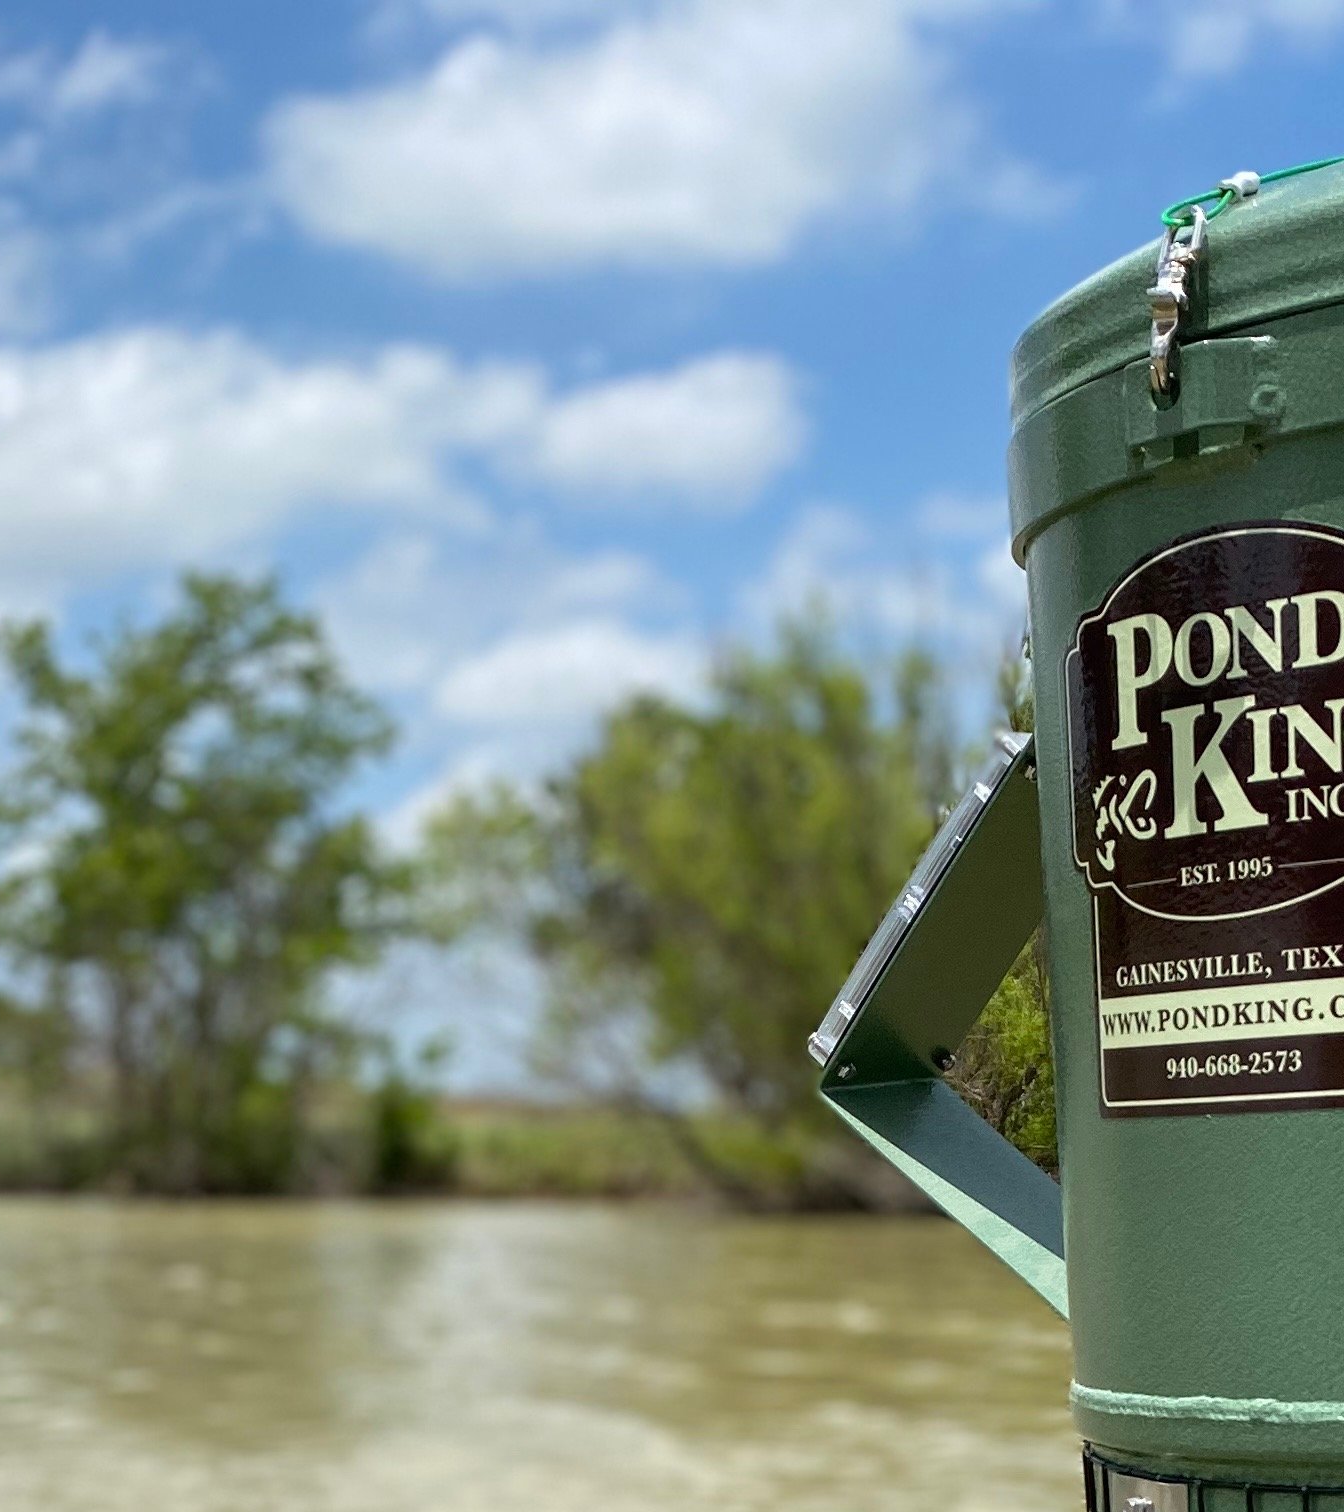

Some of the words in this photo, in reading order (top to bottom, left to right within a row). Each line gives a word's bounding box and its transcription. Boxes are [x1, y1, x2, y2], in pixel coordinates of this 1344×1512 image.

[1180, 864, 1222, 888] EST.
[1227, 856, 1274, 881] 1995
[1116, 951, 1273, 988] GAINESVILLE,
[1166, 1049, 1303, 1080] 940-668-2573
